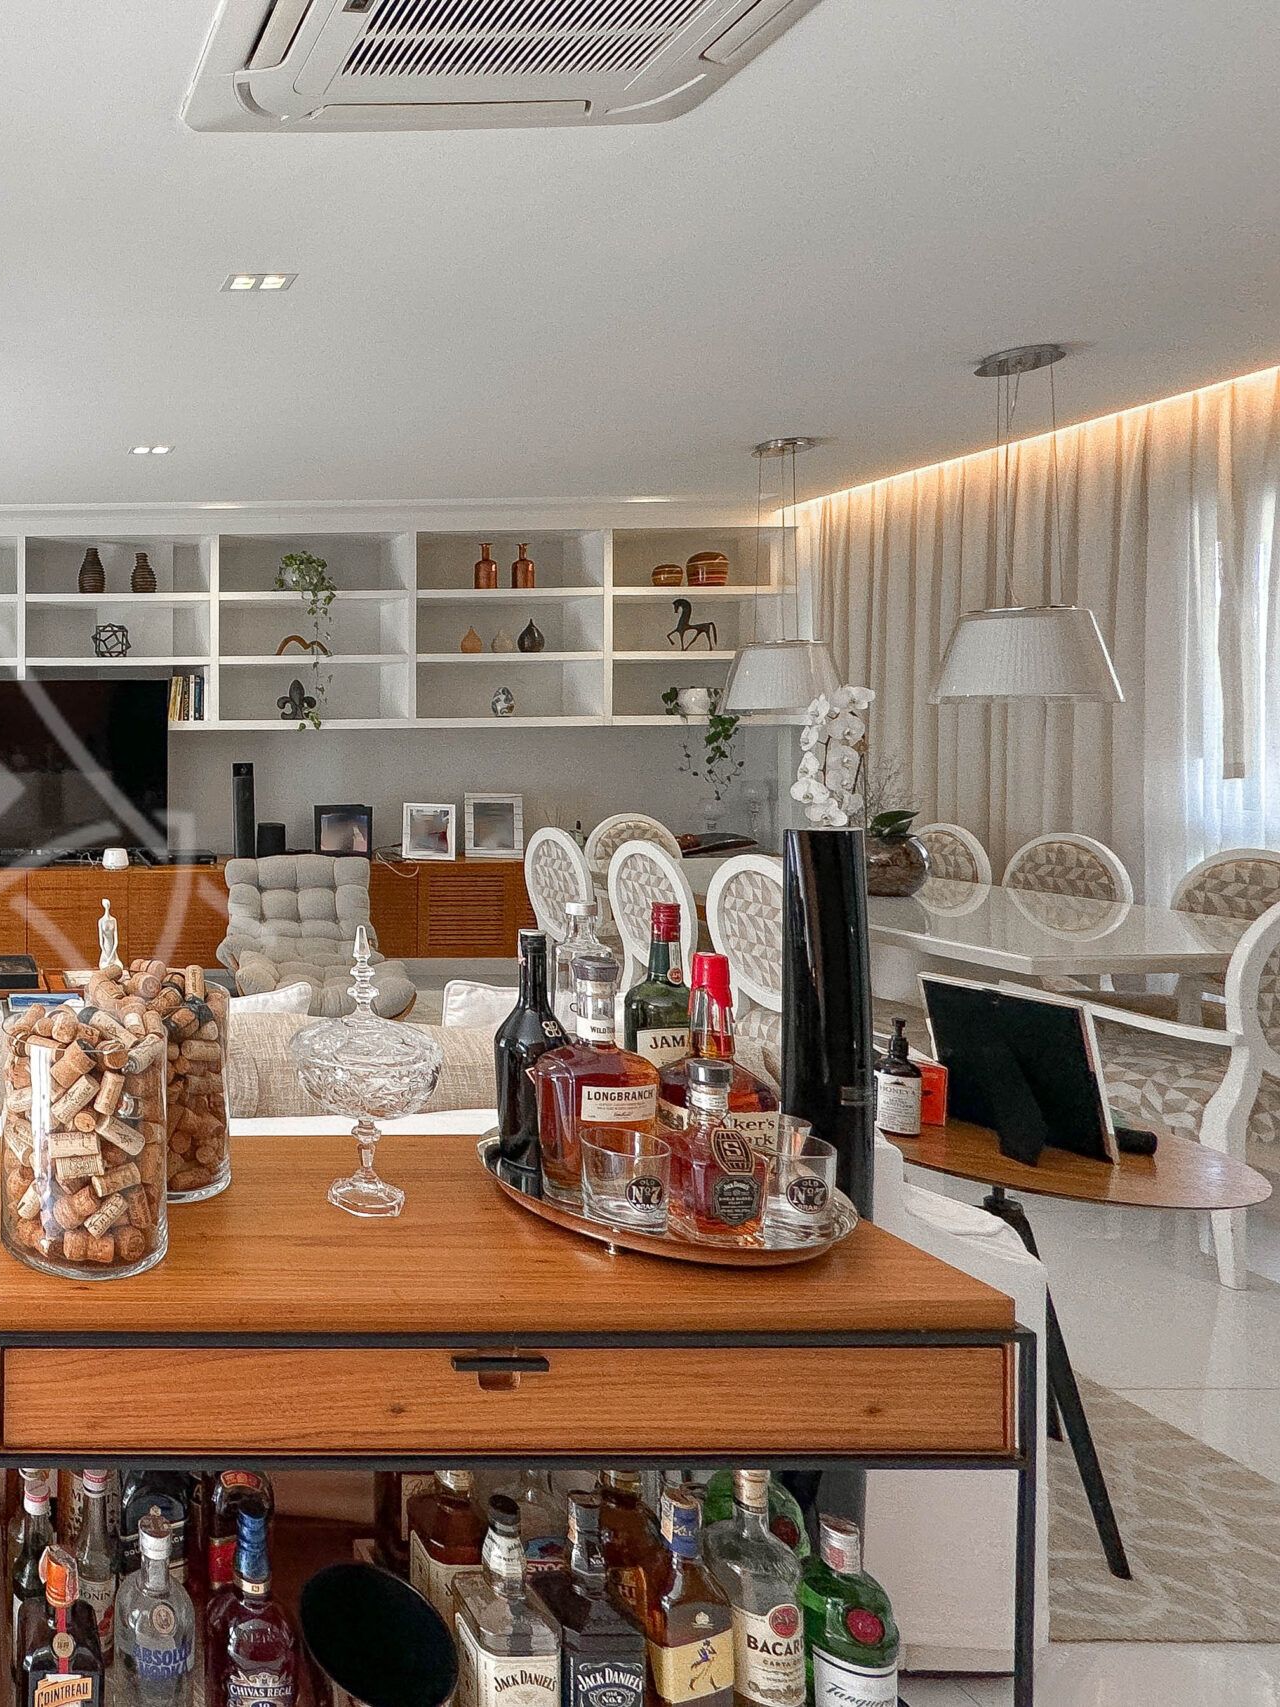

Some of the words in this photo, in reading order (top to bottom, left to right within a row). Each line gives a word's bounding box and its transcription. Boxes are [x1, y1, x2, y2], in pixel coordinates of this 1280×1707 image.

[650, 1035, 686, 1049] JAM
[587, 1089, 654, 1101] LONGBRANCH
[734, 1119, 775, 1131] ker's
[744, 1134, 775, 1146] ark
[494, 1674, 519, 1692] JACK
[520, 1670, 557, 1691] DANIEL'S
[577, 1672, 604, 1691] JACK
[605, 1667, 643, 1692] DANIEL'S
[37, 1682, 89, 1707] COINTREAU
[230, 1685, 264, 1697] CHIVAS
